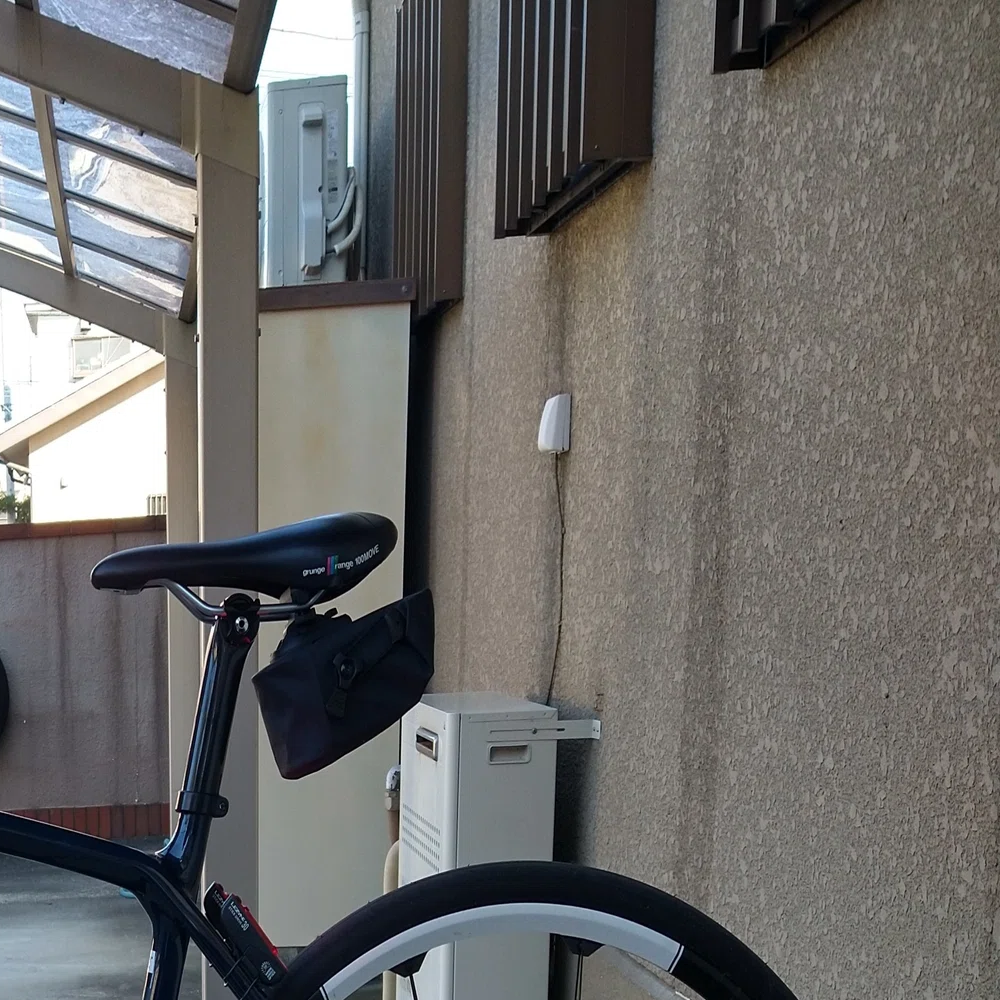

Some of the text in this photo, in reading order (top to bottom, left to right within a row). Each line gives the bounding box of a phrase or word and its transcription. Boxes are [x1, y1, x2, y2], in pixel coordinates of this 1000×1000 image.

[302, 543, 380, 578] grunge range 100MOVE
